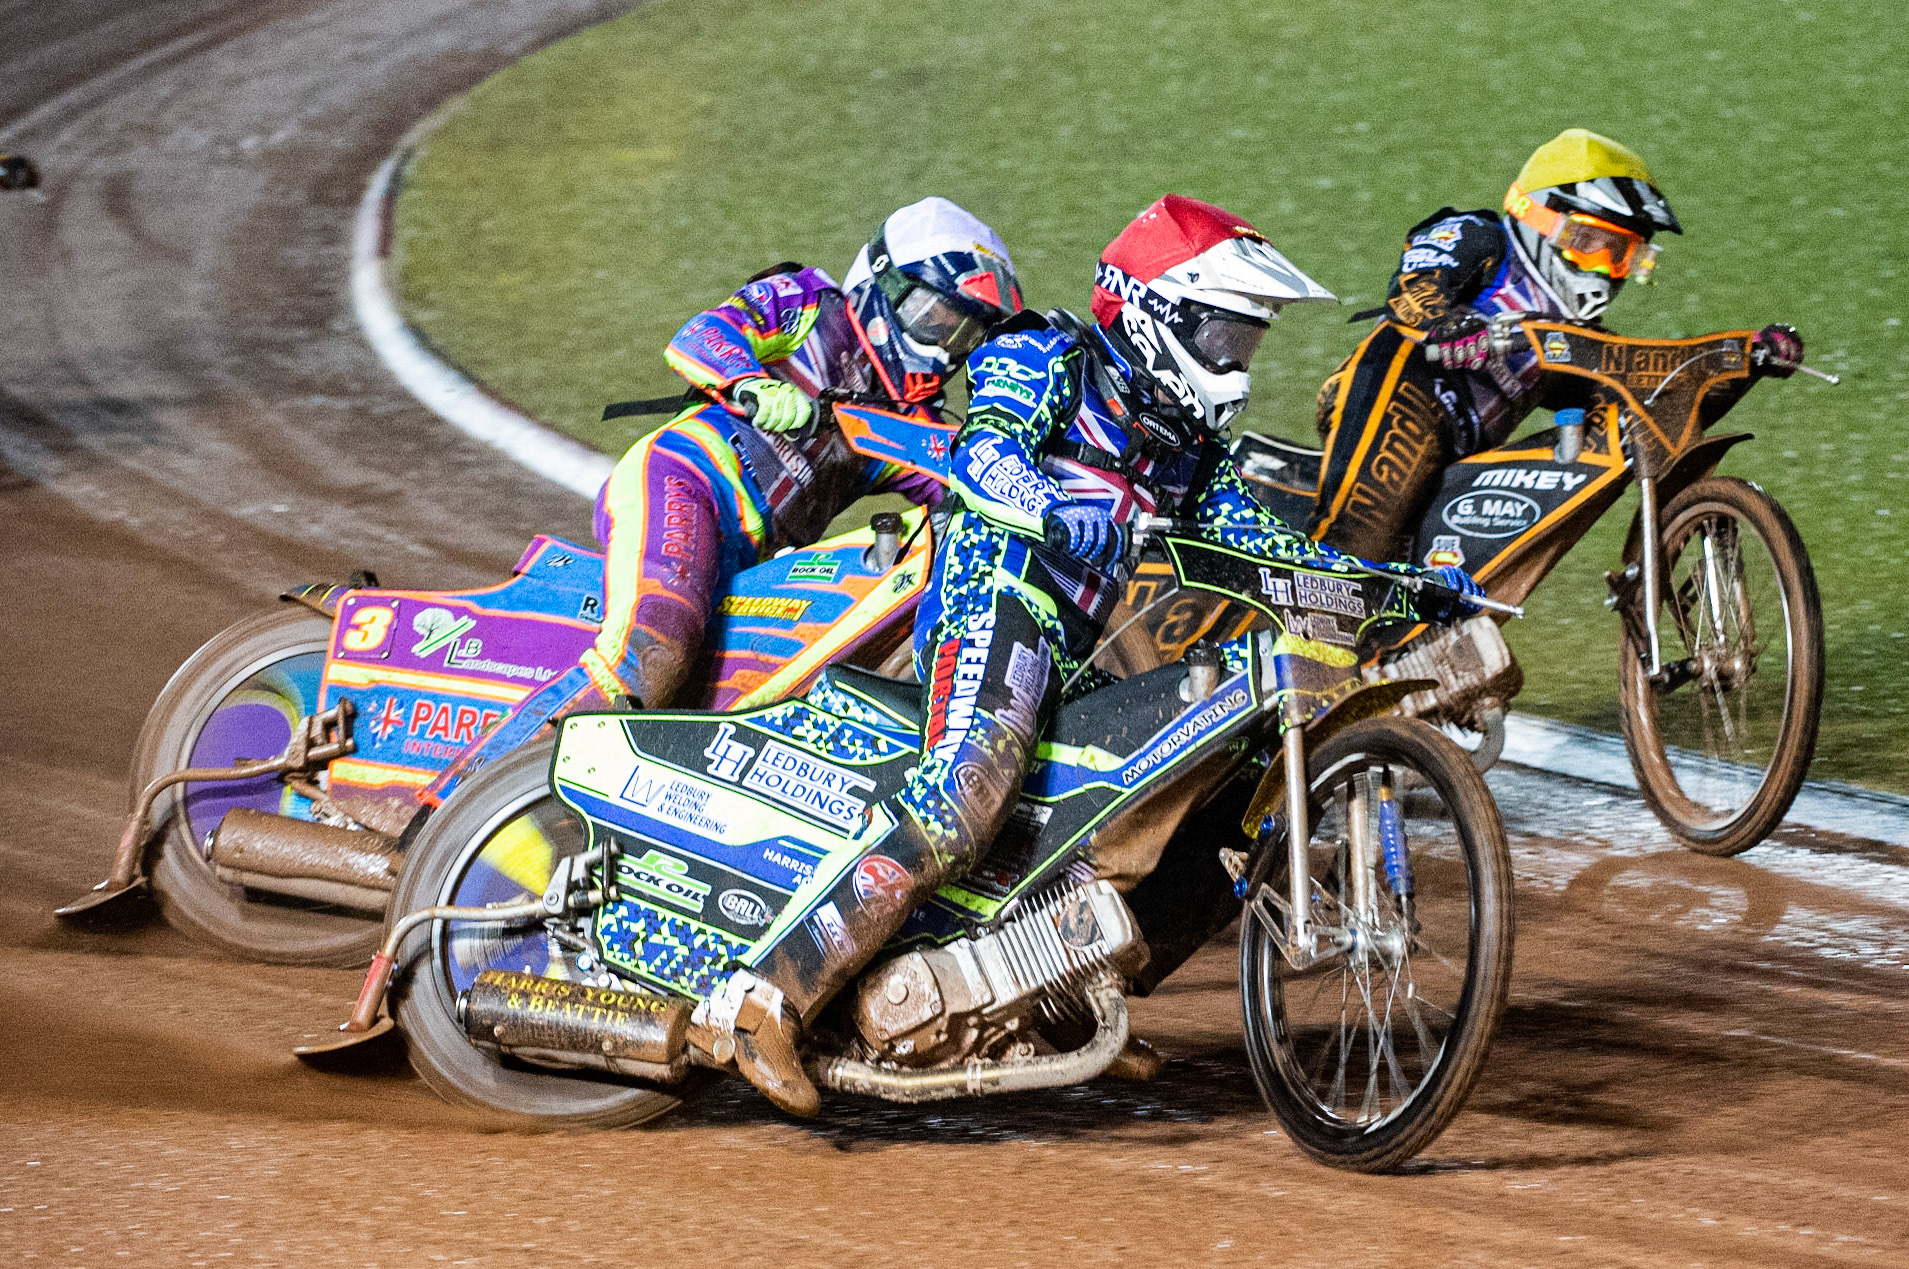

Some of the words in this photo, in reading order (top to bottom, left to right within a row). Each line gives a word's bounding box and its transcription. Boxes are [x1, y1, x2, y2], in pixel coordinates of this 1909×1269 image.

[1143, 416, 1178, 444] ORTEMA
[1471, 468, 1588, 492] MIKEY
[1482, 499, 1529, 517] MAY
[1297, 574, 1352, 597] LEDBURY
[1299, 591, 1364, 614] HOLDINGS
[342, 606, 394, 651] 3
[933, 610, 997, 764] SPEEDWAY
[1123, 688, 1247, 786] MOTORVATING
[761, 748, 851, 794] LEDBURY
[664, 791, 707, 814] WELDING
[669, 779, 713, 804] LEDBURY
[750, 767, 858, 822] HOLDINGS
[657, 802, 667, 814] &
[666, 804, 728, 836] ENGINEERING
[665, 882, 708, 904] OIL
[506, 993, 522, 1011] &
[528, 994, 630, 1027] BEATTIE
[585, 986, 668, 1013] YOUNG
